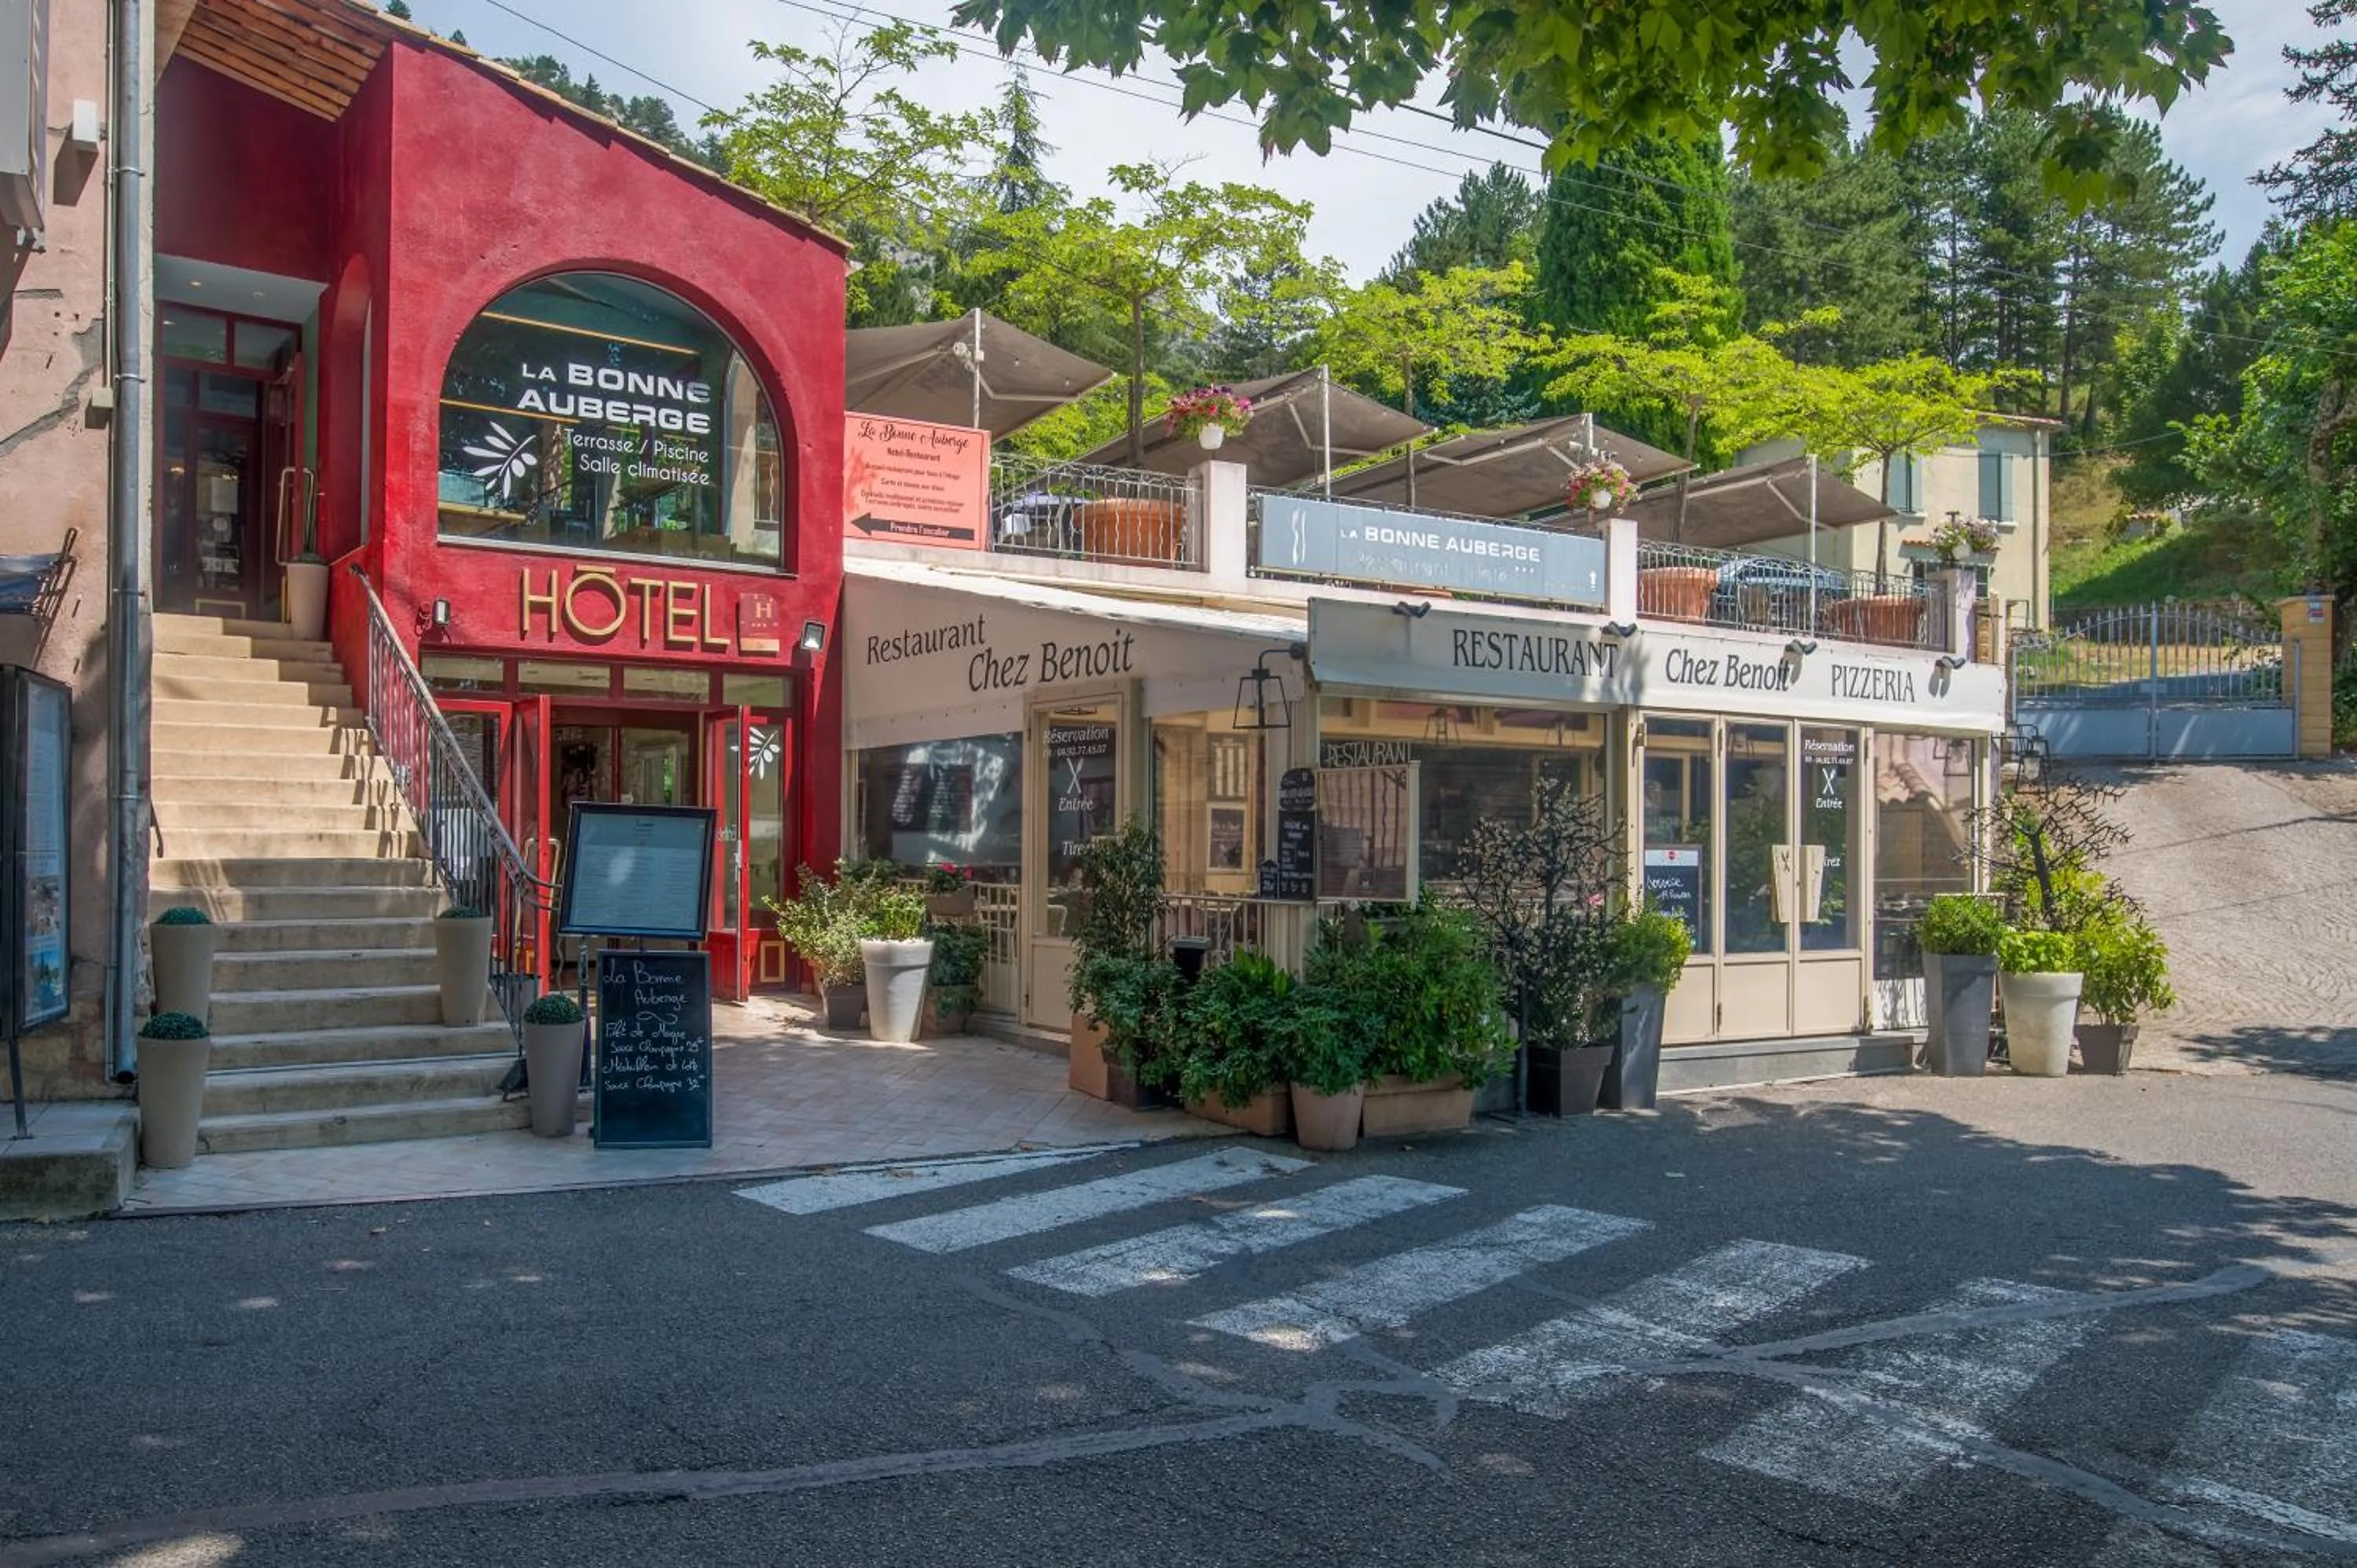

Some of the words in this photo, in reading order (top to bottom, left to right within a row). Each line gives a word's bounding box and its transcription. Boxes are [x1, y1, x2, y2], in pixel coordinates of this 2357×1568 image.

[522, 363, 557, 382] LA
[568, 362, 711, 403] BONNE
[516, 389, 711, 434] AUBERGE
[564, 428, 634, 454] Terrasse
[654, 439, 709, 463] Piscine
[858, 421, 875, 441] La
[879, 423, 916, 442] Bonne
[920, 430, 969, 454] Auberge
[579, 453, 621, 474] Salle
[628, 461, 709, 485] climatisée
[1340, 529, 1358, 539] LA
[1365, 526, 1440, 550] BONNE
[1445, 537, 1541, 562] AUBERGE
[756, 603, 772, 619] H
[867, 613, 986, 665] Restaurant
[969, 647, 1031, 692] Chez
[1039, 628, 1135, 683] Benoit
[1453, 628, 1619, 678] RESTAURANT
[1666, 648, 1720, 686] Chez
[1723, 654, 1791, 692] Benoit
[1831, 664, 1915, 703] PIZZERIA
[1043, 726, 1109, 744] Réservation
[1805, 739, 1855, 753] Réservation
[1327, 742, 1413, 768] RESTAURANT
[1058, 795, 1094, 812] Entrée
[1816, 797, 1843, 808] Entrée
[603, 958, 626, 984] La
[633, 960, 683, 984] Bonne
[634, 987, 687, 1011] Auberge
